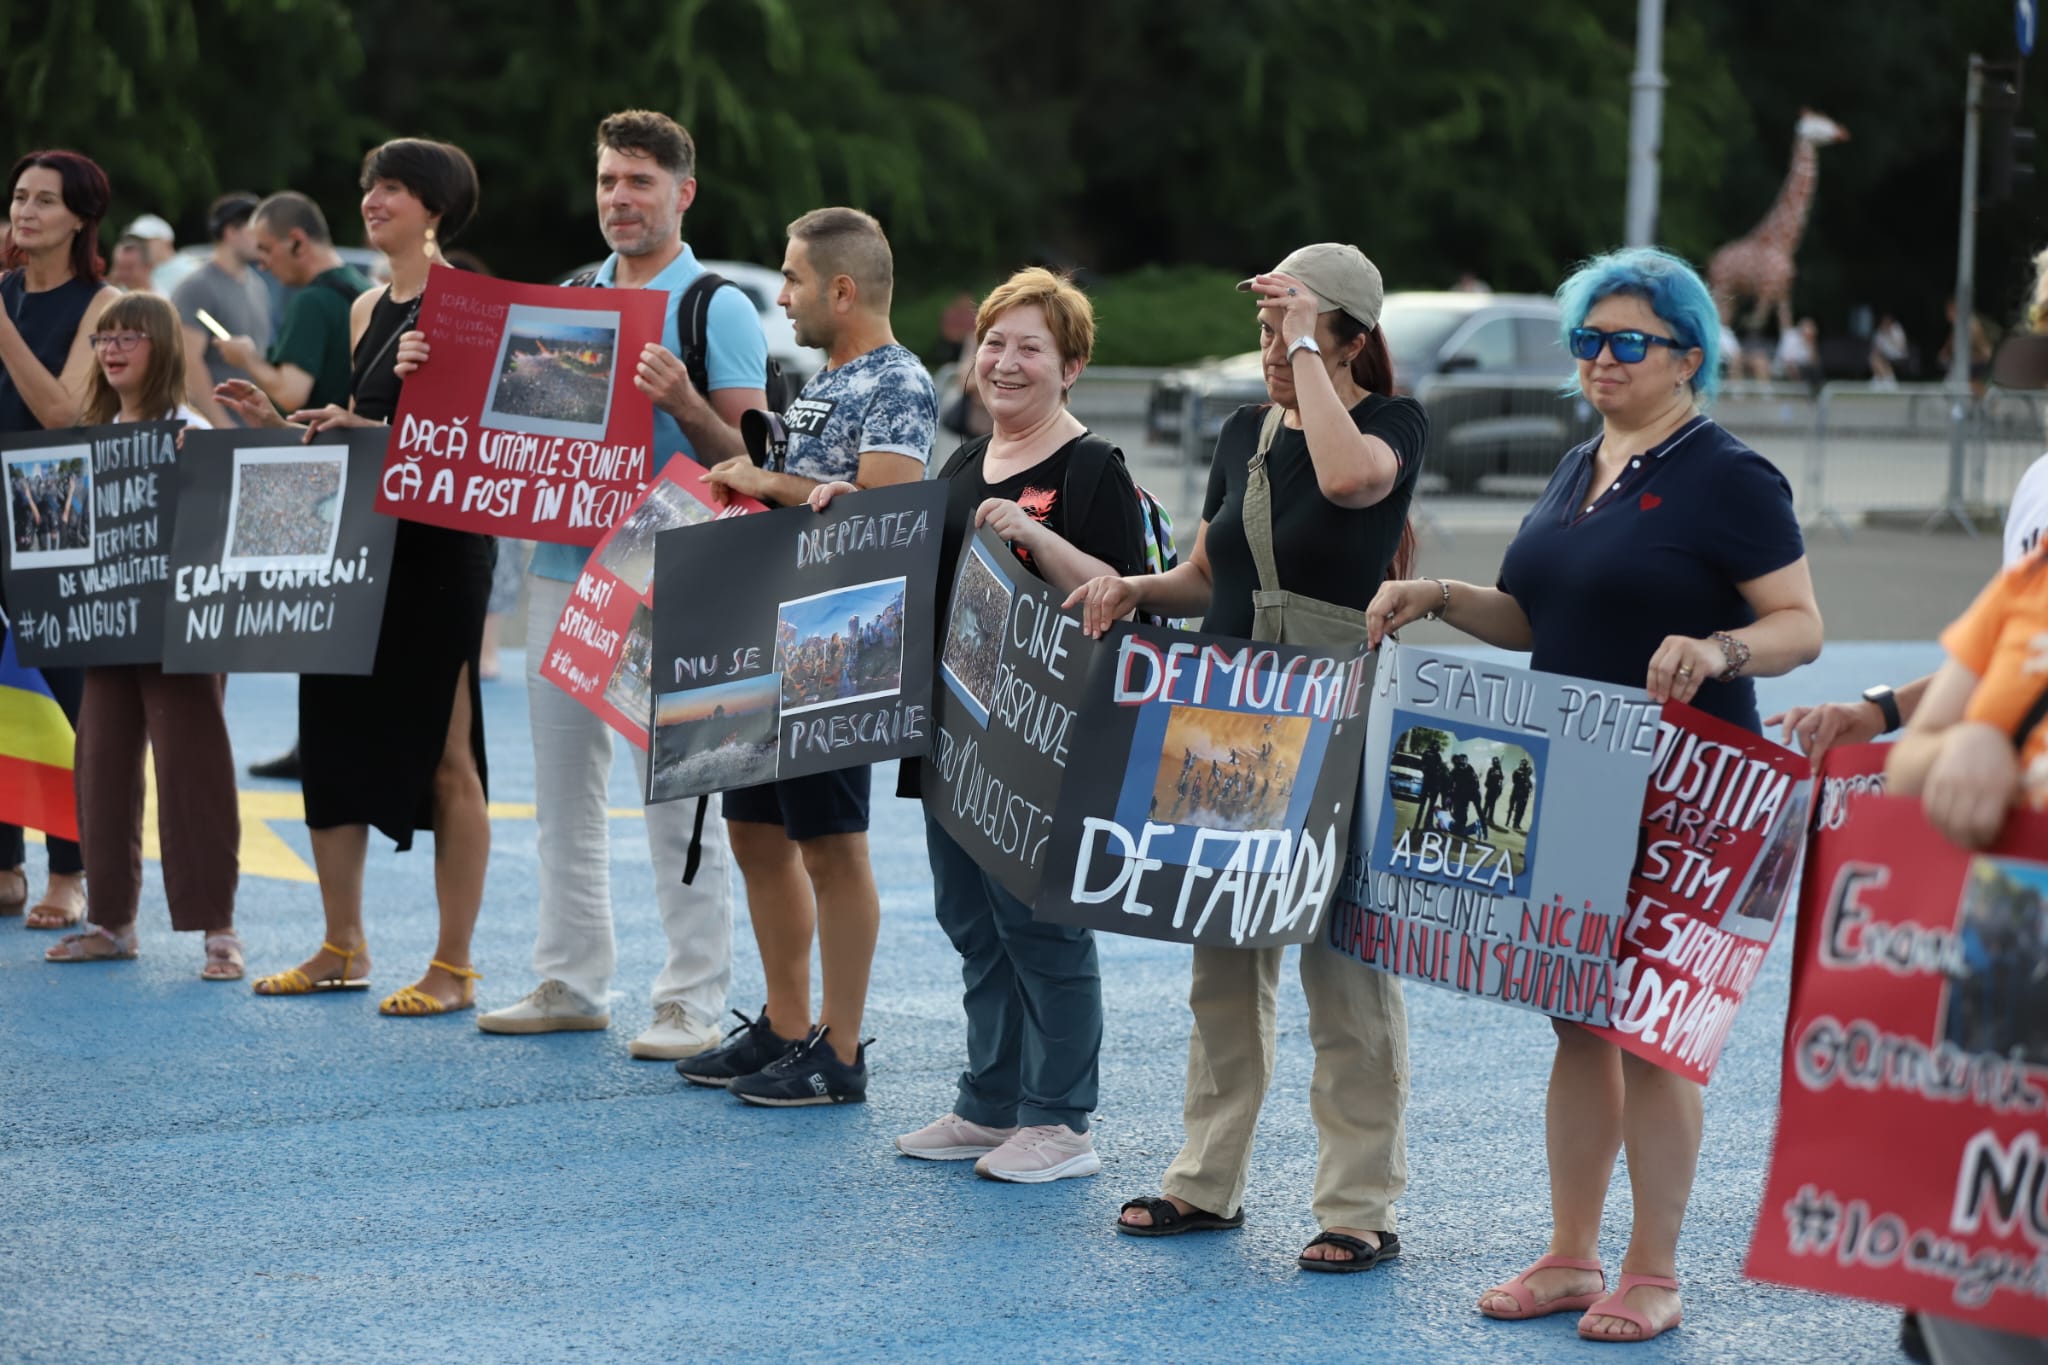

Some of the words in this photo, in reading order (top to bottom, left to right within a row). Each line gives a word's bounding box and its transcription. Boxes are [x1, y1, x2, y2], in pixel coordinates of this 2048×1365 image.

[398, 413, 469, 460] DACĂ
[536, 437, 565, 477] LE
[561, 441, 646, 481] SPUNEM
[97, 480, 121, 518] NU
[123, 472, 159, 514] ARE
[383, 455, 423, 501] CĂ
[427, 468, 455, 504] A
[460, 475, 527, 517] FOST
[531, 477, 567, 523] ÎN
[96, 515, 159, 560] TERMEN
[796, 509, 929, 569] DREPTATEA
[58, 572, 77, 598] DE
[175, 562, 248, 602] ERAM
[18, 610, 62, 649] #10
[66, 597, 141, 643] AUGUST
[186, 602, 225, 643] NU
[1013, 590, 1081, 681] CINE
[674, 653, 719, 684] NU
[725, 647, 761, 676] SE
[789, 700, 928, 760] PRESCRIE
[1411, 658, 1550, 738] STATUL
[1558, 684, 1664, 757] POATE
[1070, 816, 1176, 918] DE
[1388, 829, 1516, 893] ABUZA
